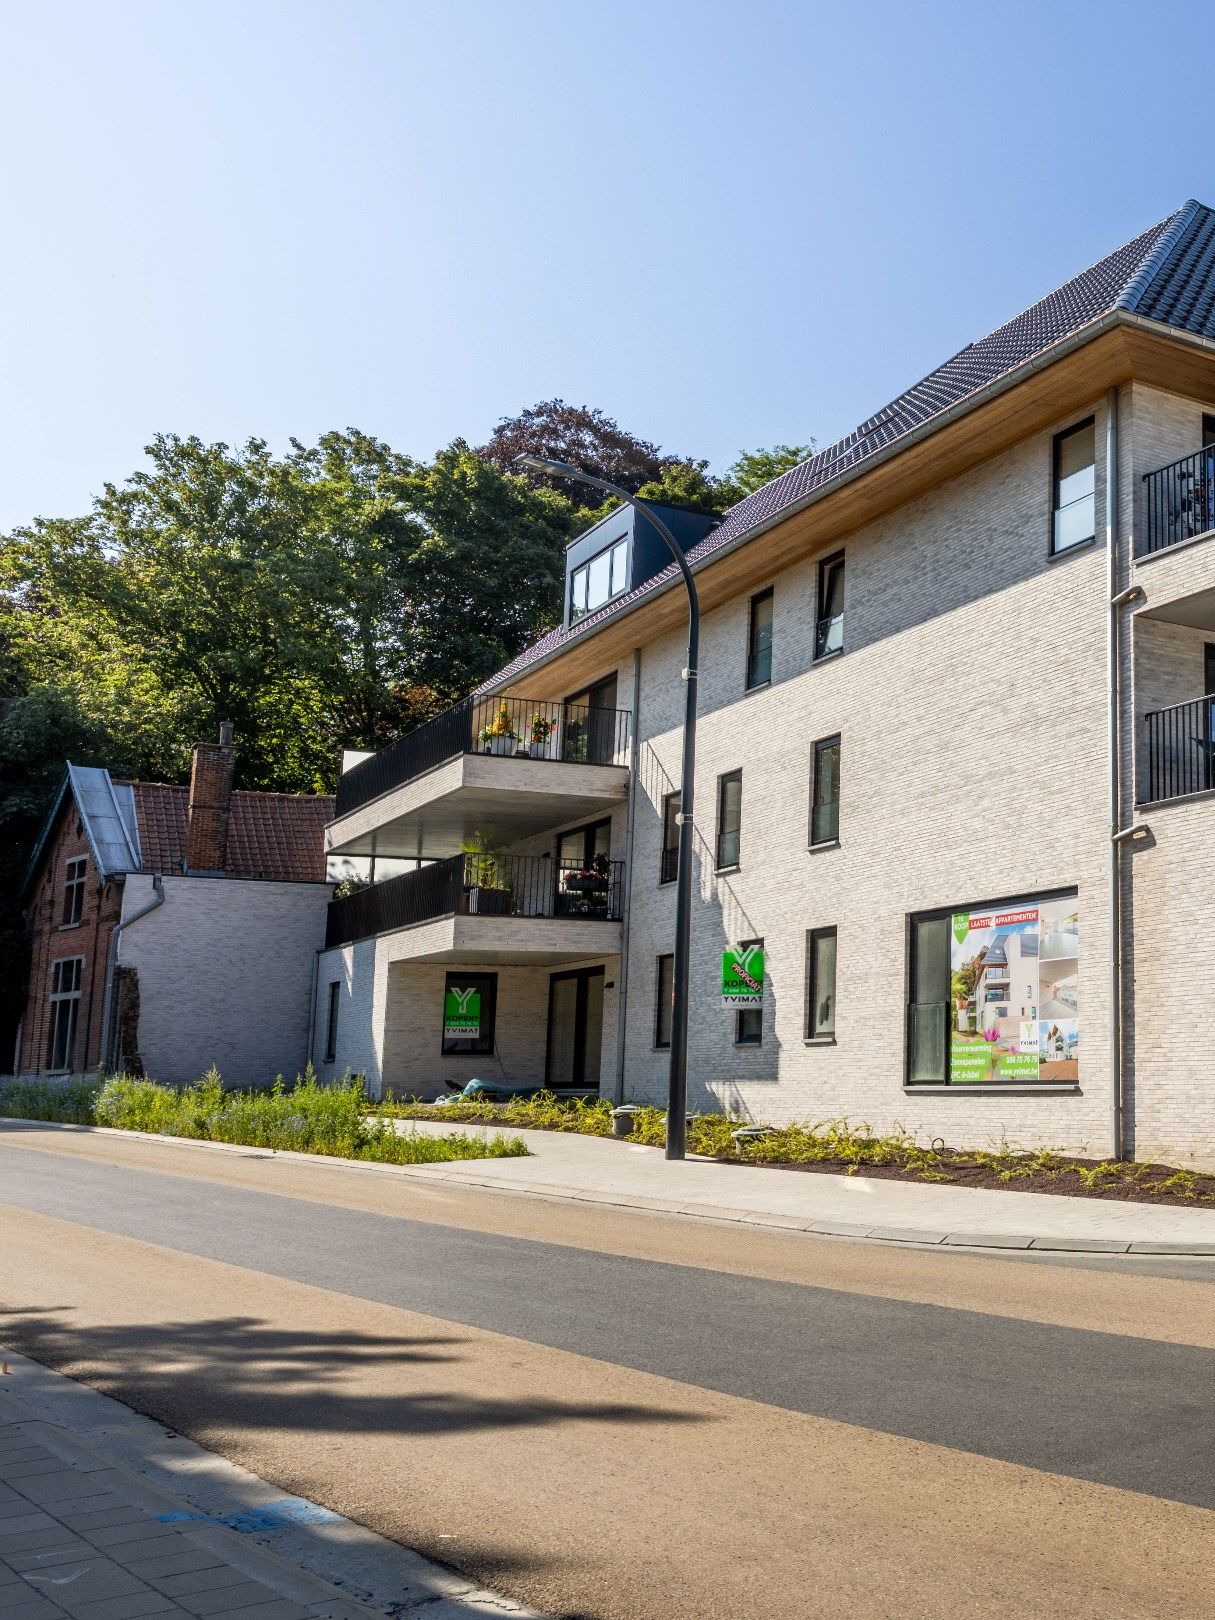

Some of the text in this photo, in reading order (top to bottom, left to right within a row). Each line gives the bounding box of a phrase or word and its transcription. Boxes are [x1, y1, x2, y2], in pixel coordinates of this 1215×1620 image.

[970, 919, 991, 928] LAATSTE
[732, 963, 761, 991] PROFICIAT
[450, 988, 476, 1013] Y
